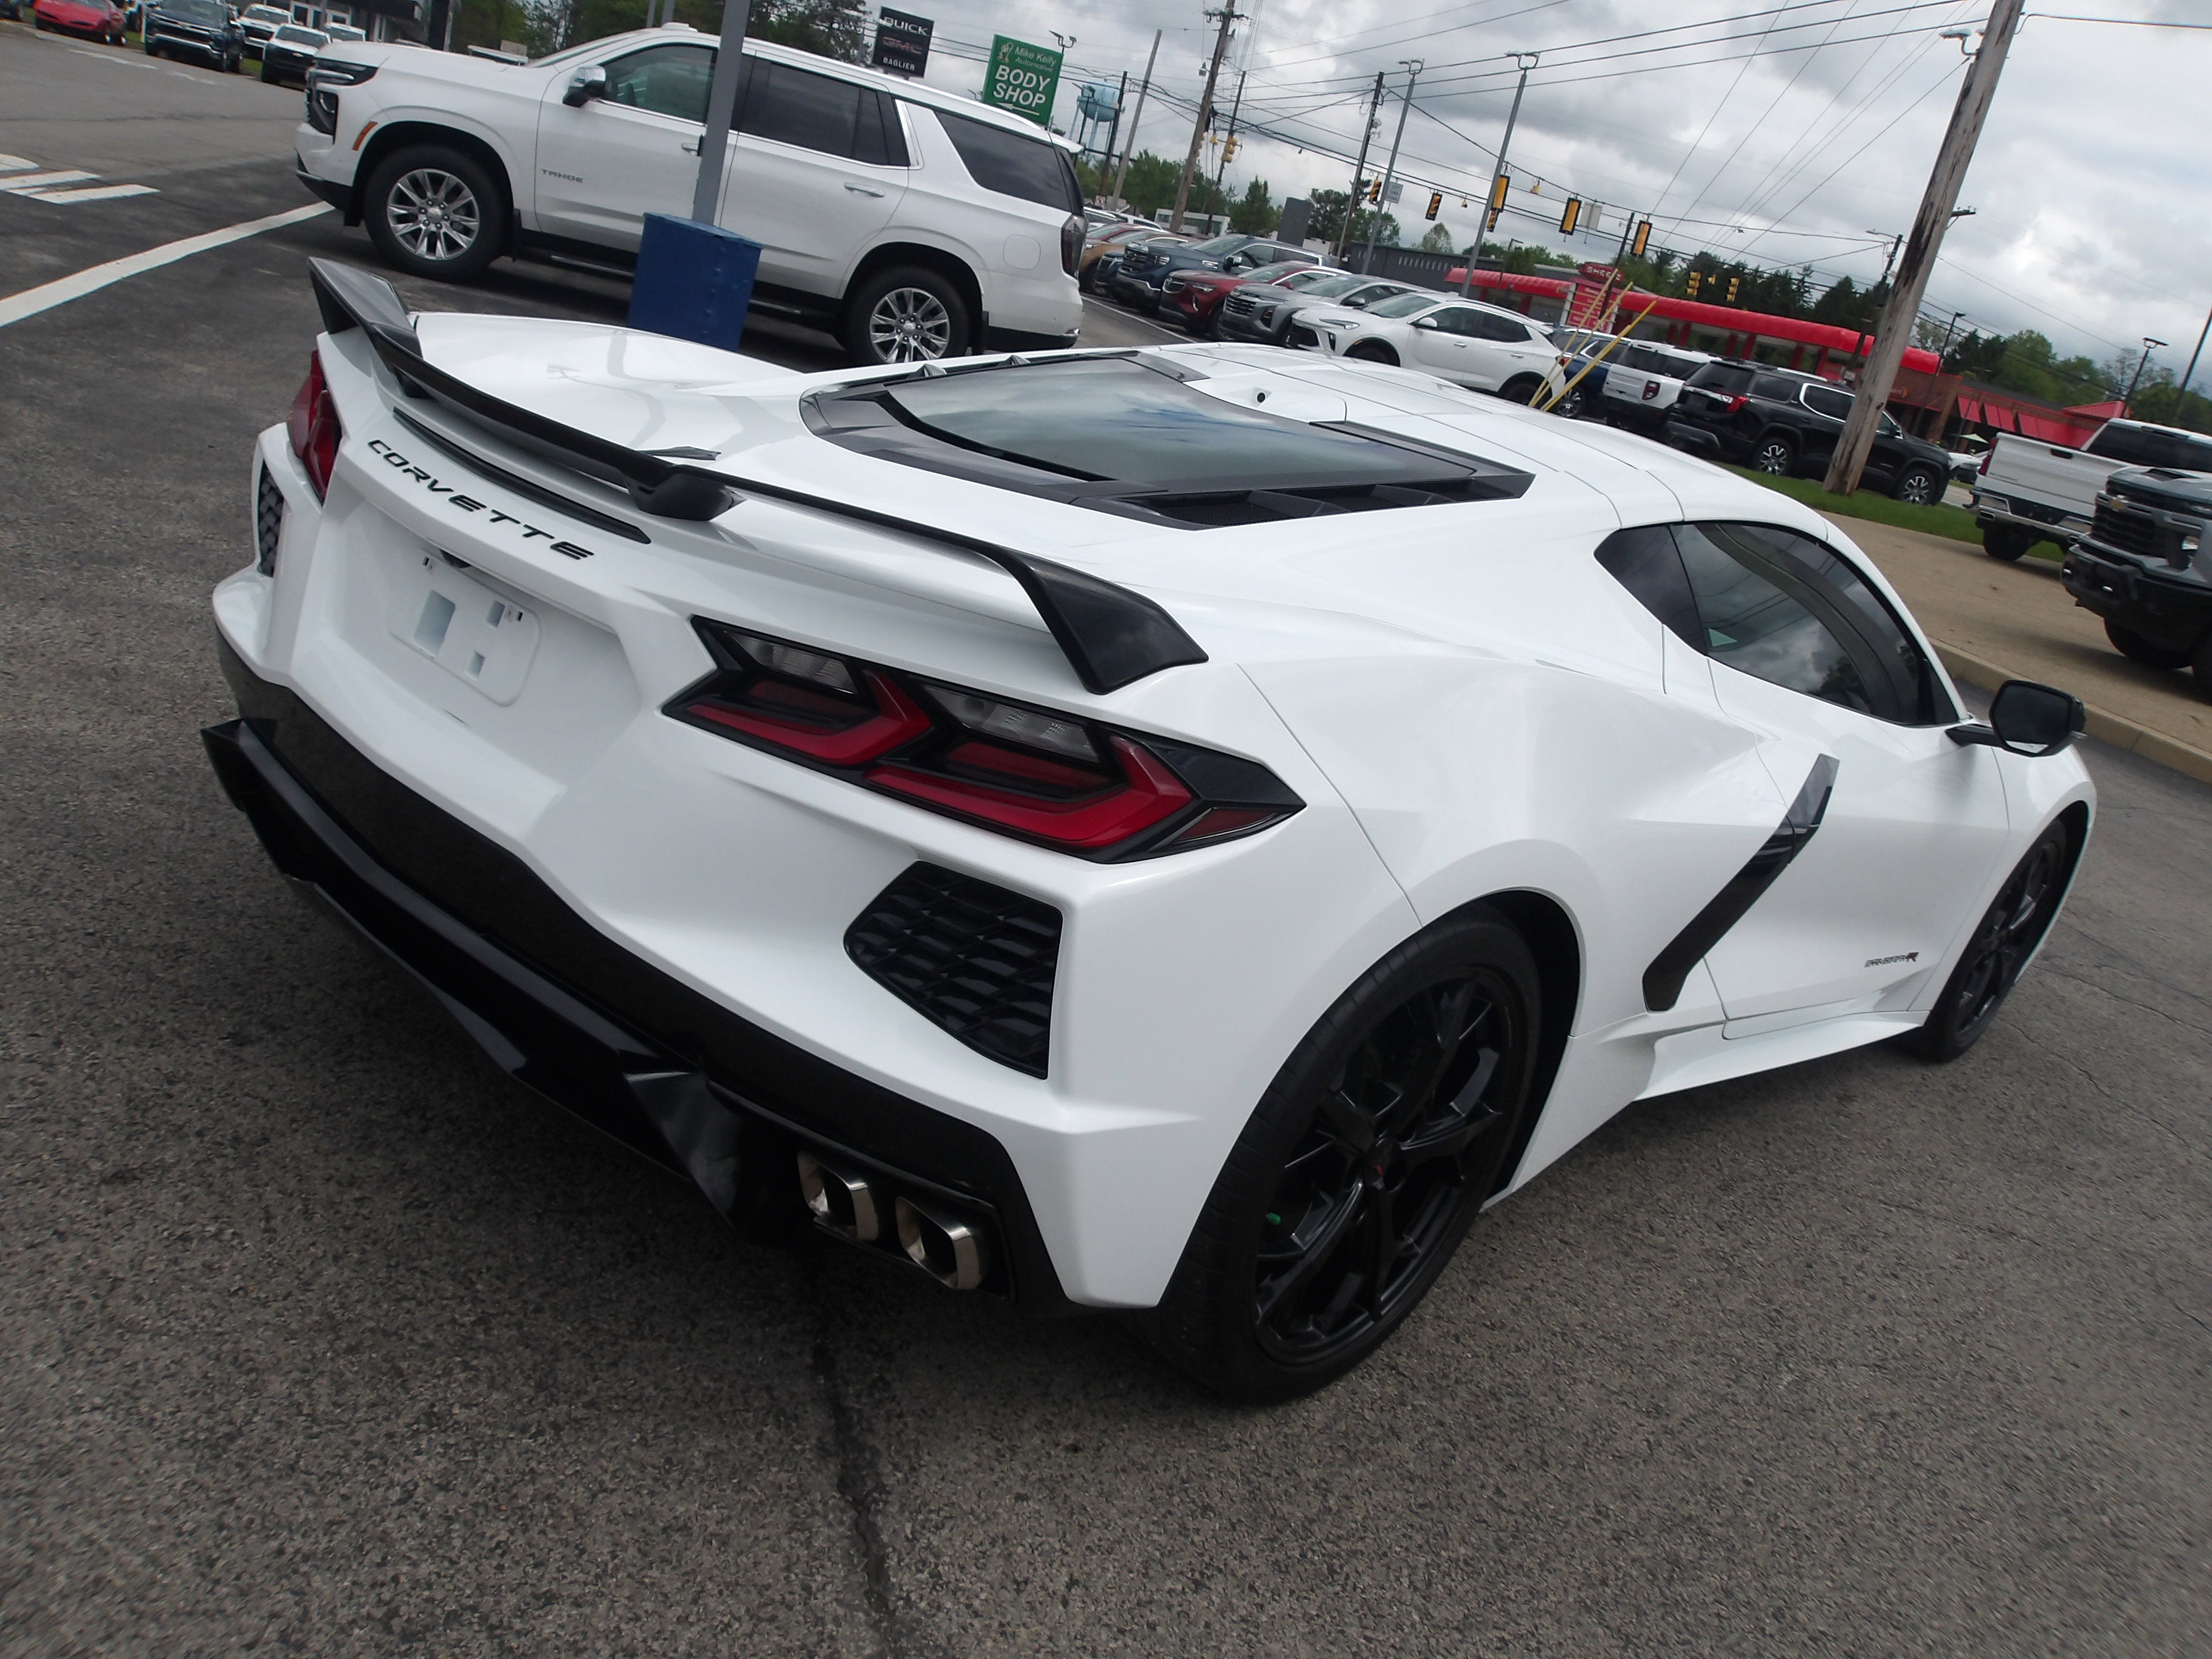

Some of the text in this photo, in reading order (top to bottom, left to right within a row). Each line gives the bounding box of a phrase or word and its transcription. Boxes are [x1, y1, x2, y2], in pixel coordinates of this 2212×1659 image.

[883, 16, 928, 36] BUICK
[883, 36, 923, 55] GMC
[883, 56, 915, 71] BAGLIER
[1015, 46, 1056, 66] Mike Kelly
[1015, 57, 1053, 72] Automotive
[995, 64, 1051, 92] BODY
[993, 83, 1046, 107] SHOP
[541, 168, 583, 183] TAHOE
[1587, 266, 1622, 281] SHEEZ
[368, 439, 594, 560] CORVETTE
